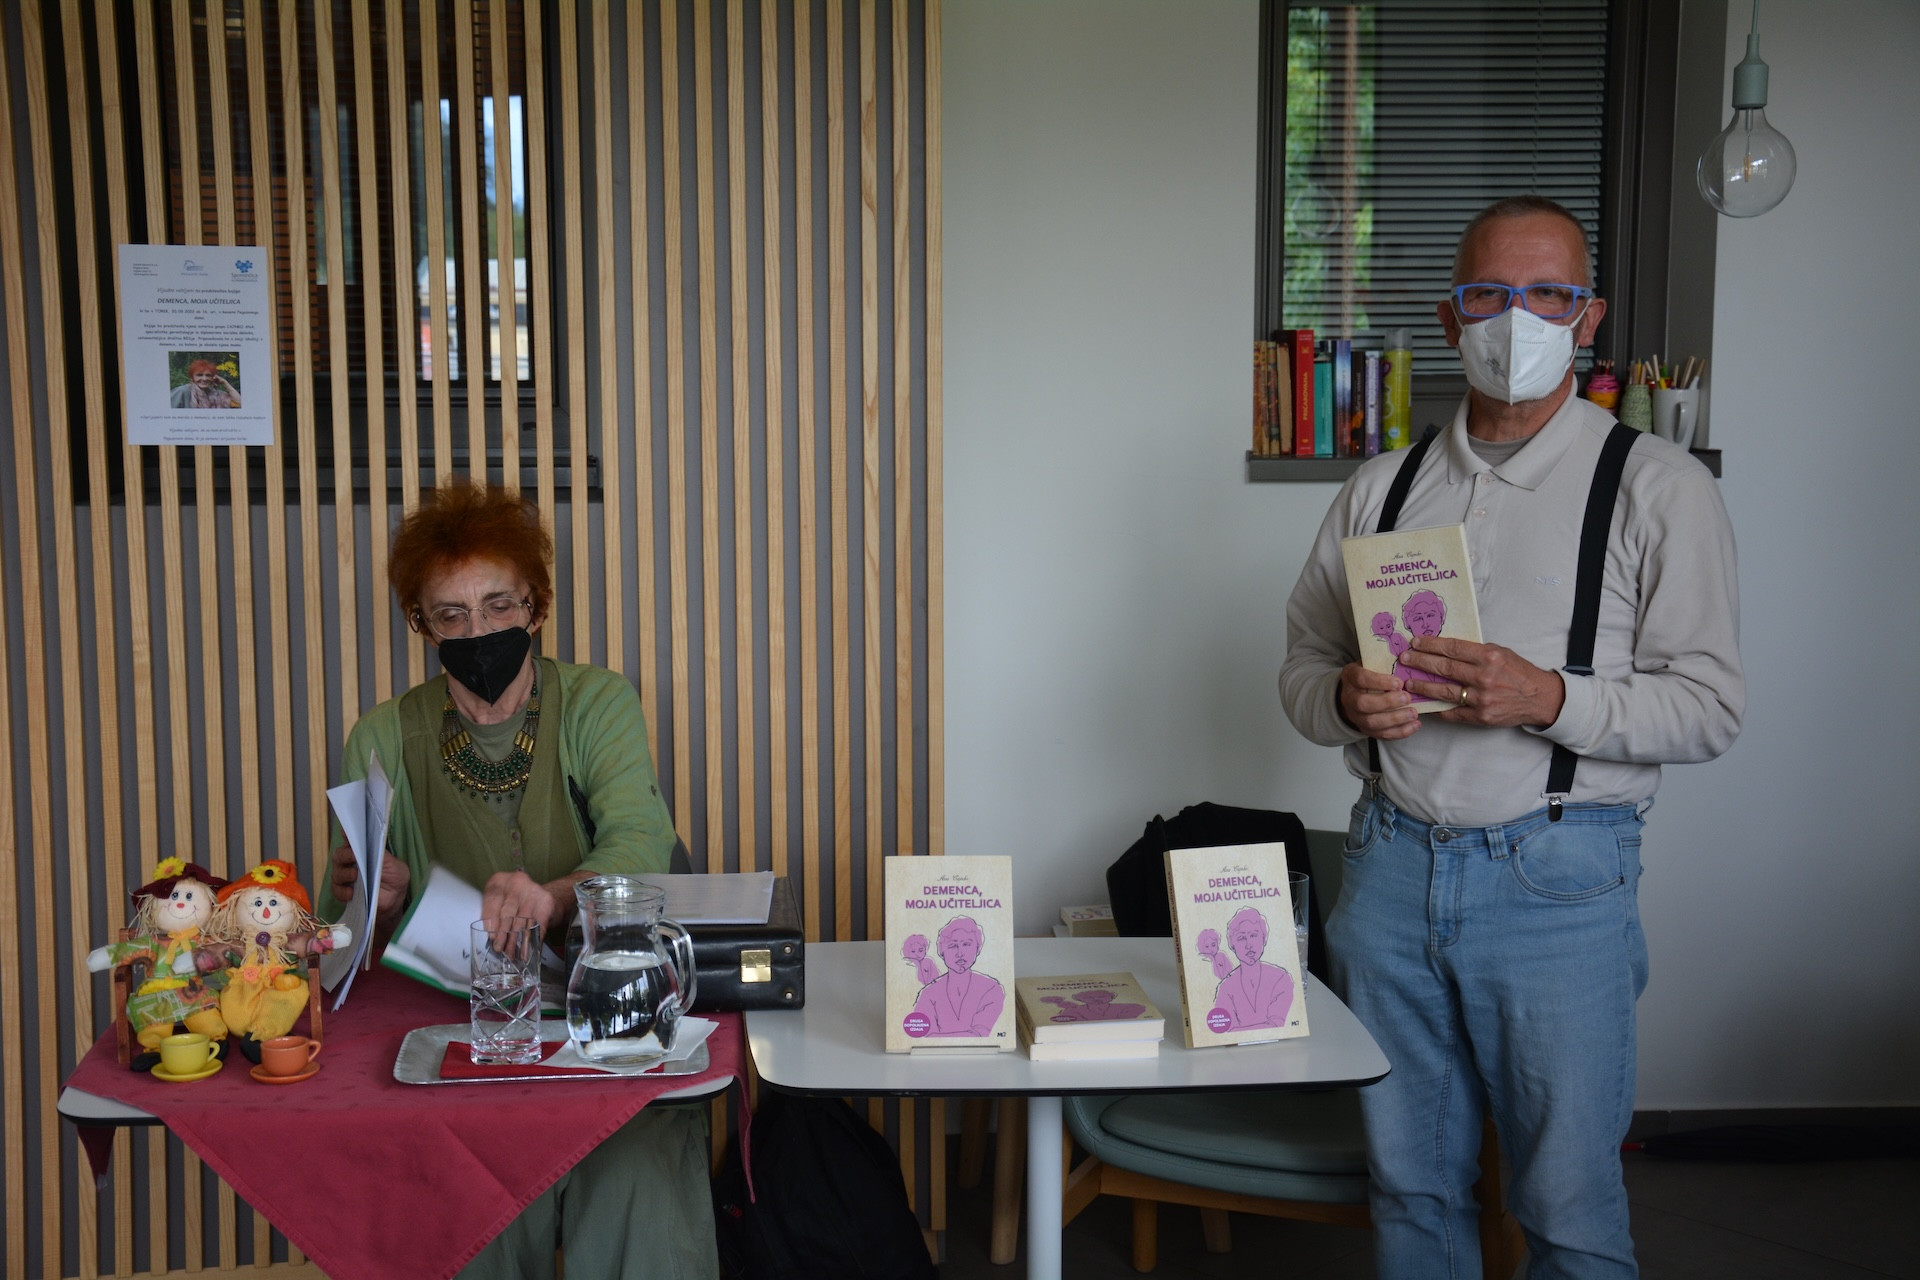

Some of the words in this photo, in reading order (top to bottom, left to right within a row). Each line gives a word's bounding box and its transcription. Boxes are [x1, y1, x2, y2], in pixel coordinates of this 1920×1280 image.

[1380, 559, 1437, 574] DEMENCA,
[1366, 576, 1396, 589] MOJA
[1397, 570, 1458, 586] UČITELJICA
[1209, 875, 1262, 888] DEMENCA,
[923, 886, 982, 897] DEMENCA,
[1194, 893, 1222, 903] MOJA
[1224, 887, 1280, 901] UČITELJICA
[905, 899, 937, 909] MOJA
[939, 897, 1001, 909] UČITELJICA
